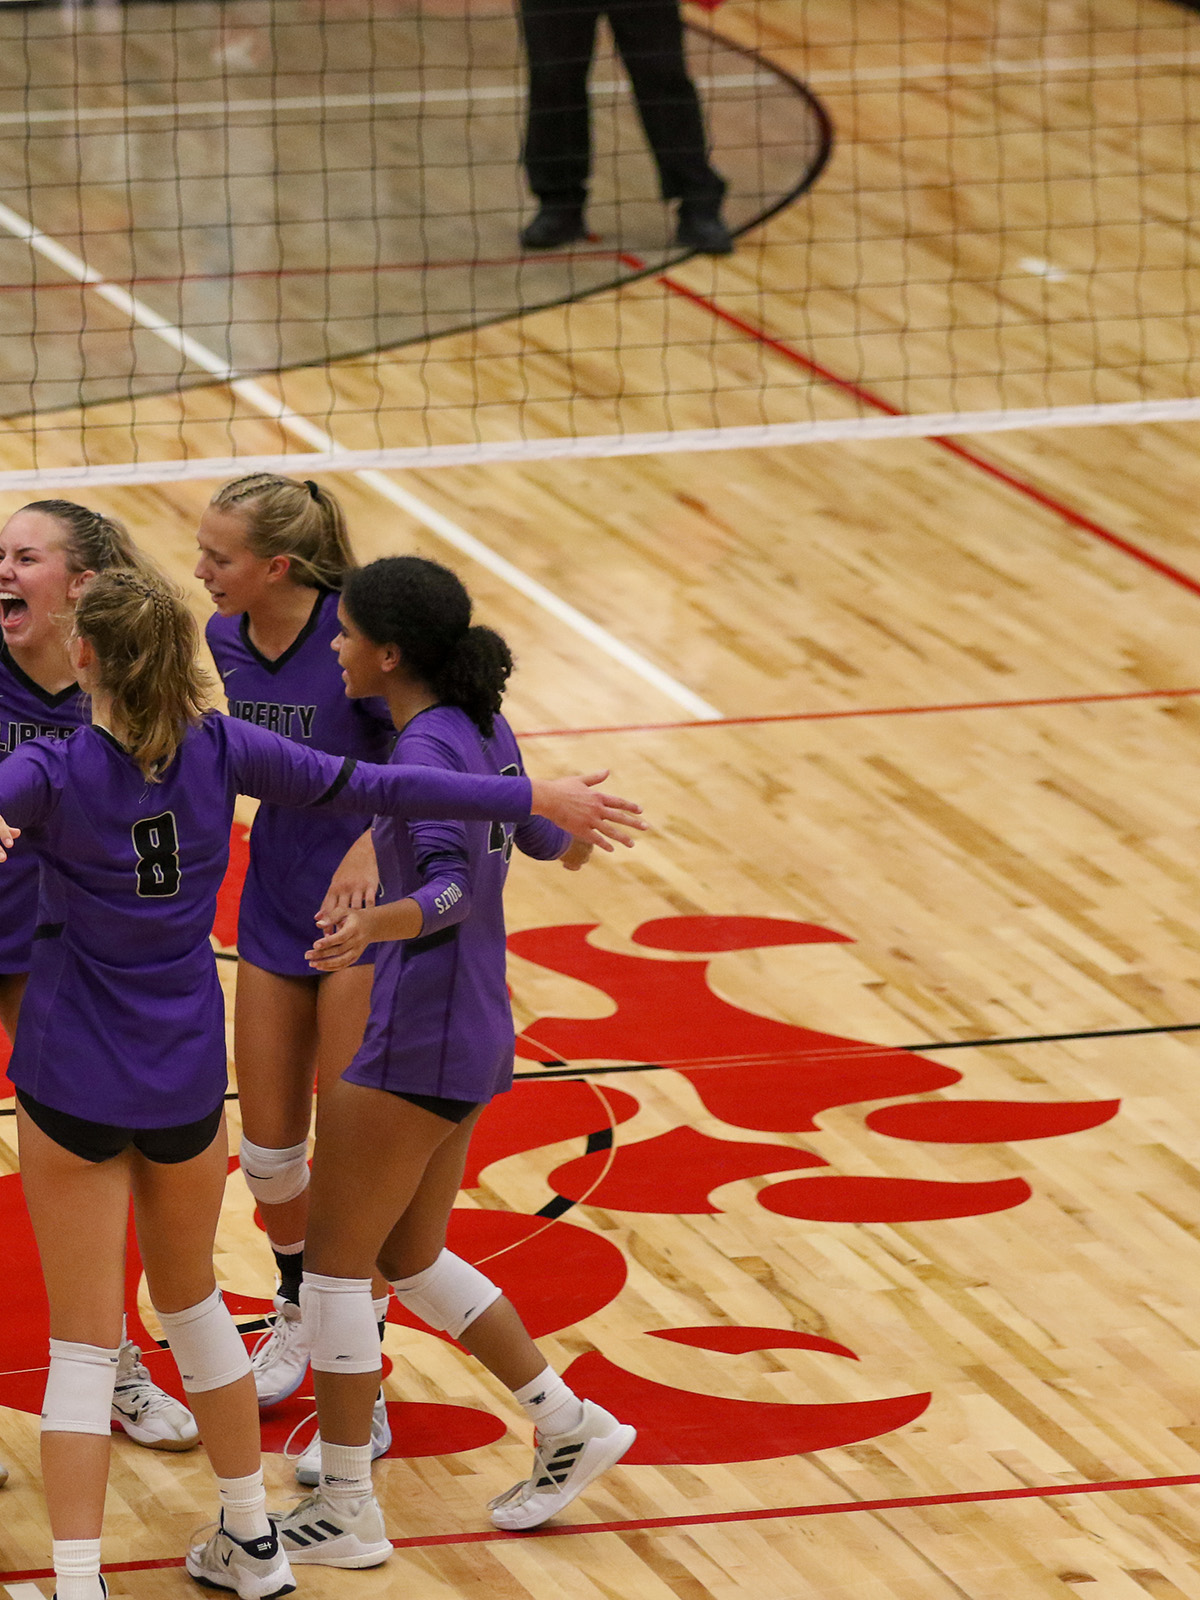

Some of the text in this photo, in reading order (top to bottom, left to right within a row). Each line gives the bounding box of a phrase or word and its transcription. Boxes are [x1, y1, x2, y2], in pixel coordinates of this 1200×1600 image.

[228, 700, 317, 739] IBERTY
[131, 810, 182, 898] 8
[435, 882, 463, 915] BOLTS
